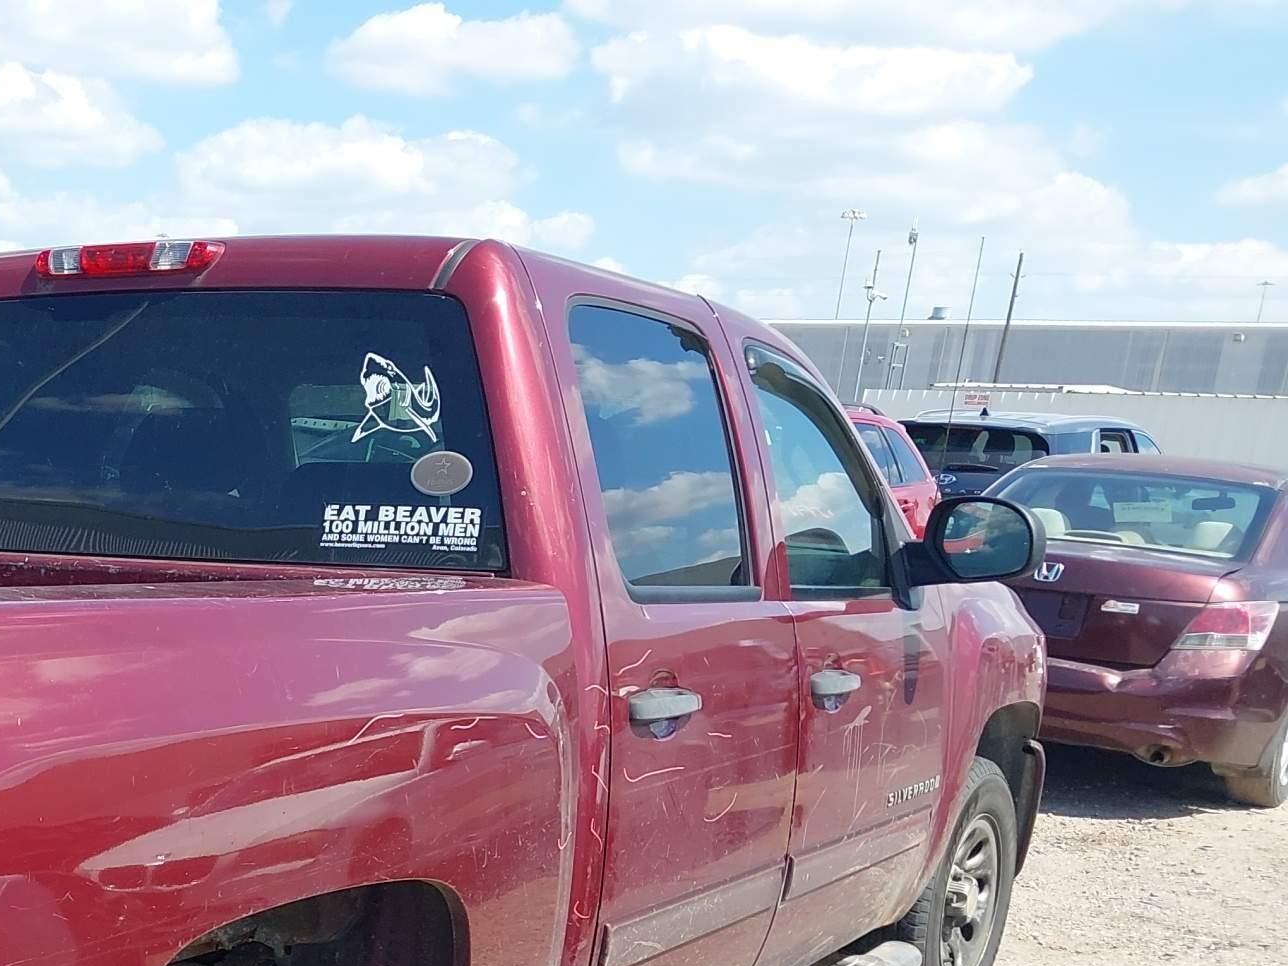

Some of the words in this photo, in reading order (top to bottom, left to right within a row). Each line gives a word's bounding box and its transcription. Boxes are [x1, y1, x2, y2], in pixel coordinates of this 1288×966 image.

[324, 504, 371, 522] EAT
[378, 505, 481, 524] BEAVER
[323, 521, 353, 534] 100
[357, 521, 433, 536] MILLION
[438, 523, 480, 537] MEN
[321, 533, 339, 541] AND
[341, 534, 365, 542] SOME
[367, 535, 400, 543] WOMEN
[401, 535, 427, 544] CAN'T
[429, 536, 442, 544] BE
[443, 537, 477, 545] WRONG
[887, 775, 940, 807] SILVERADO
